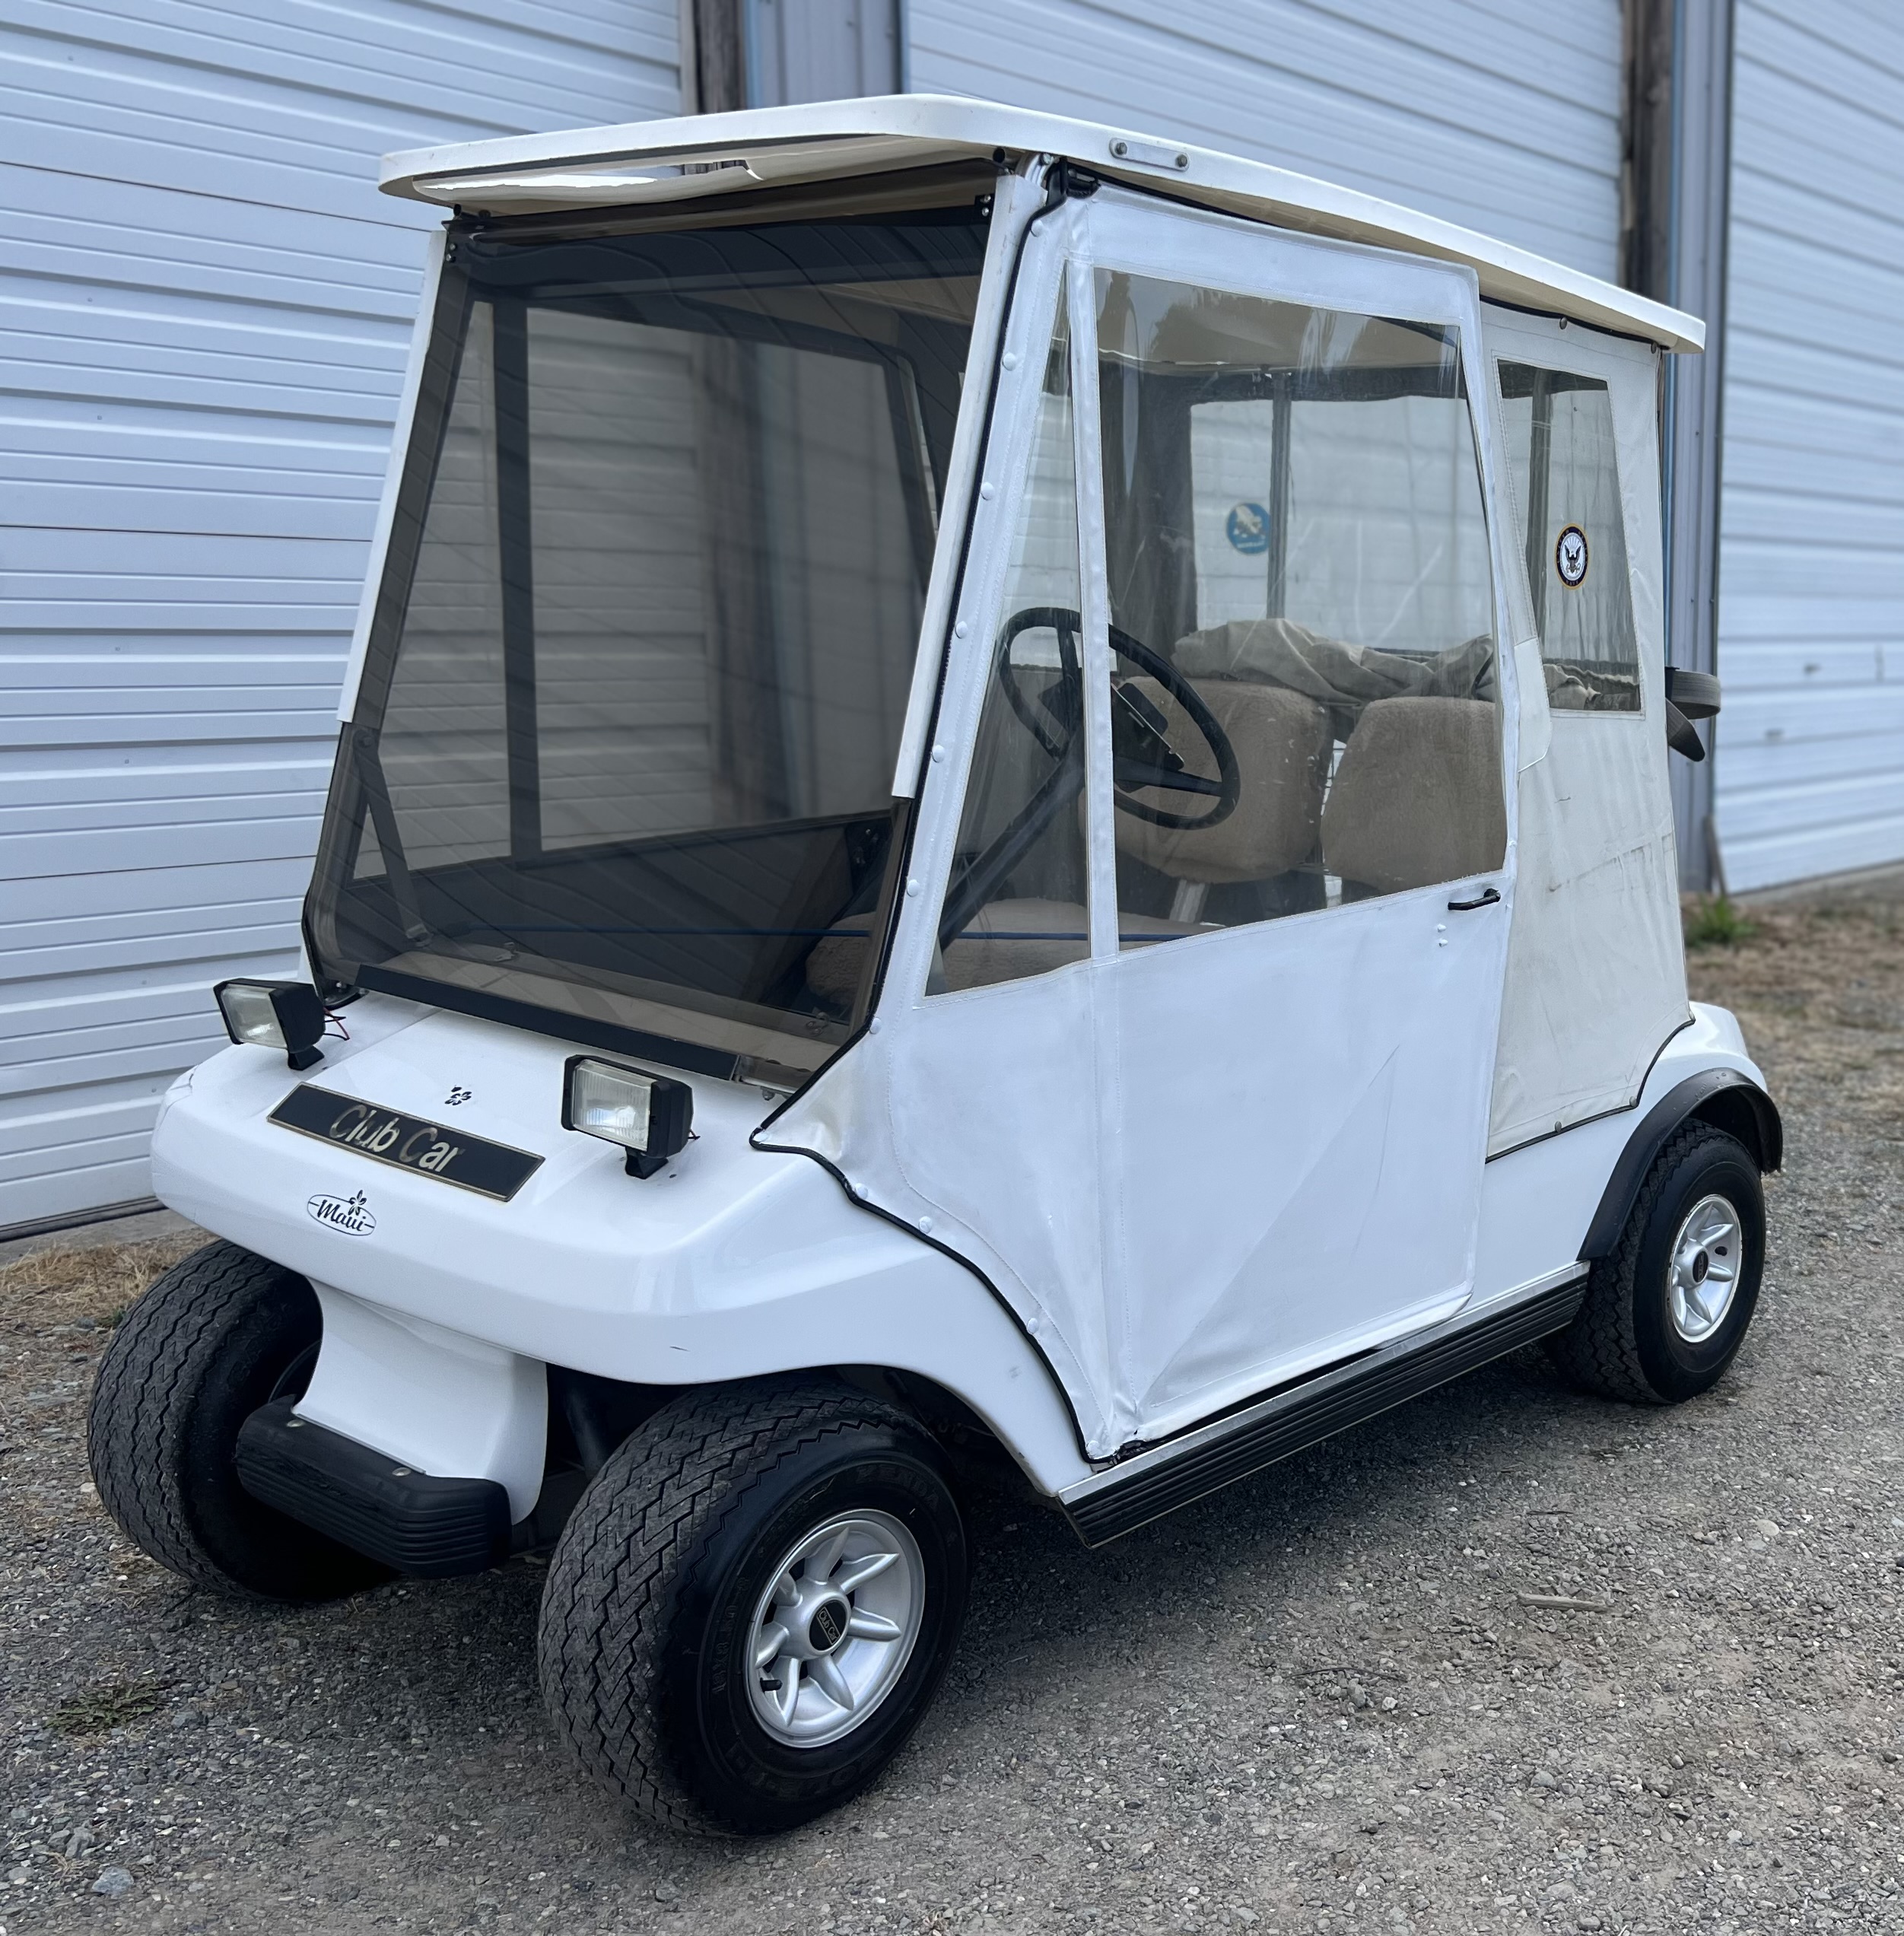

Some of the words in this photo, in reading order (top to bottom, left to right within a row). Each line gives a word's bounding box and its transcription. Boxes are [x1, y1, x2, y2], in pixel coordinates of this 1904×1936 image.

[330, 1105, 399, 1152] Club
[399, 1127, 465, 1172] Car
[317, 1199, 367, 1232] Maui
[819, 1610, 830, 1629] Club
